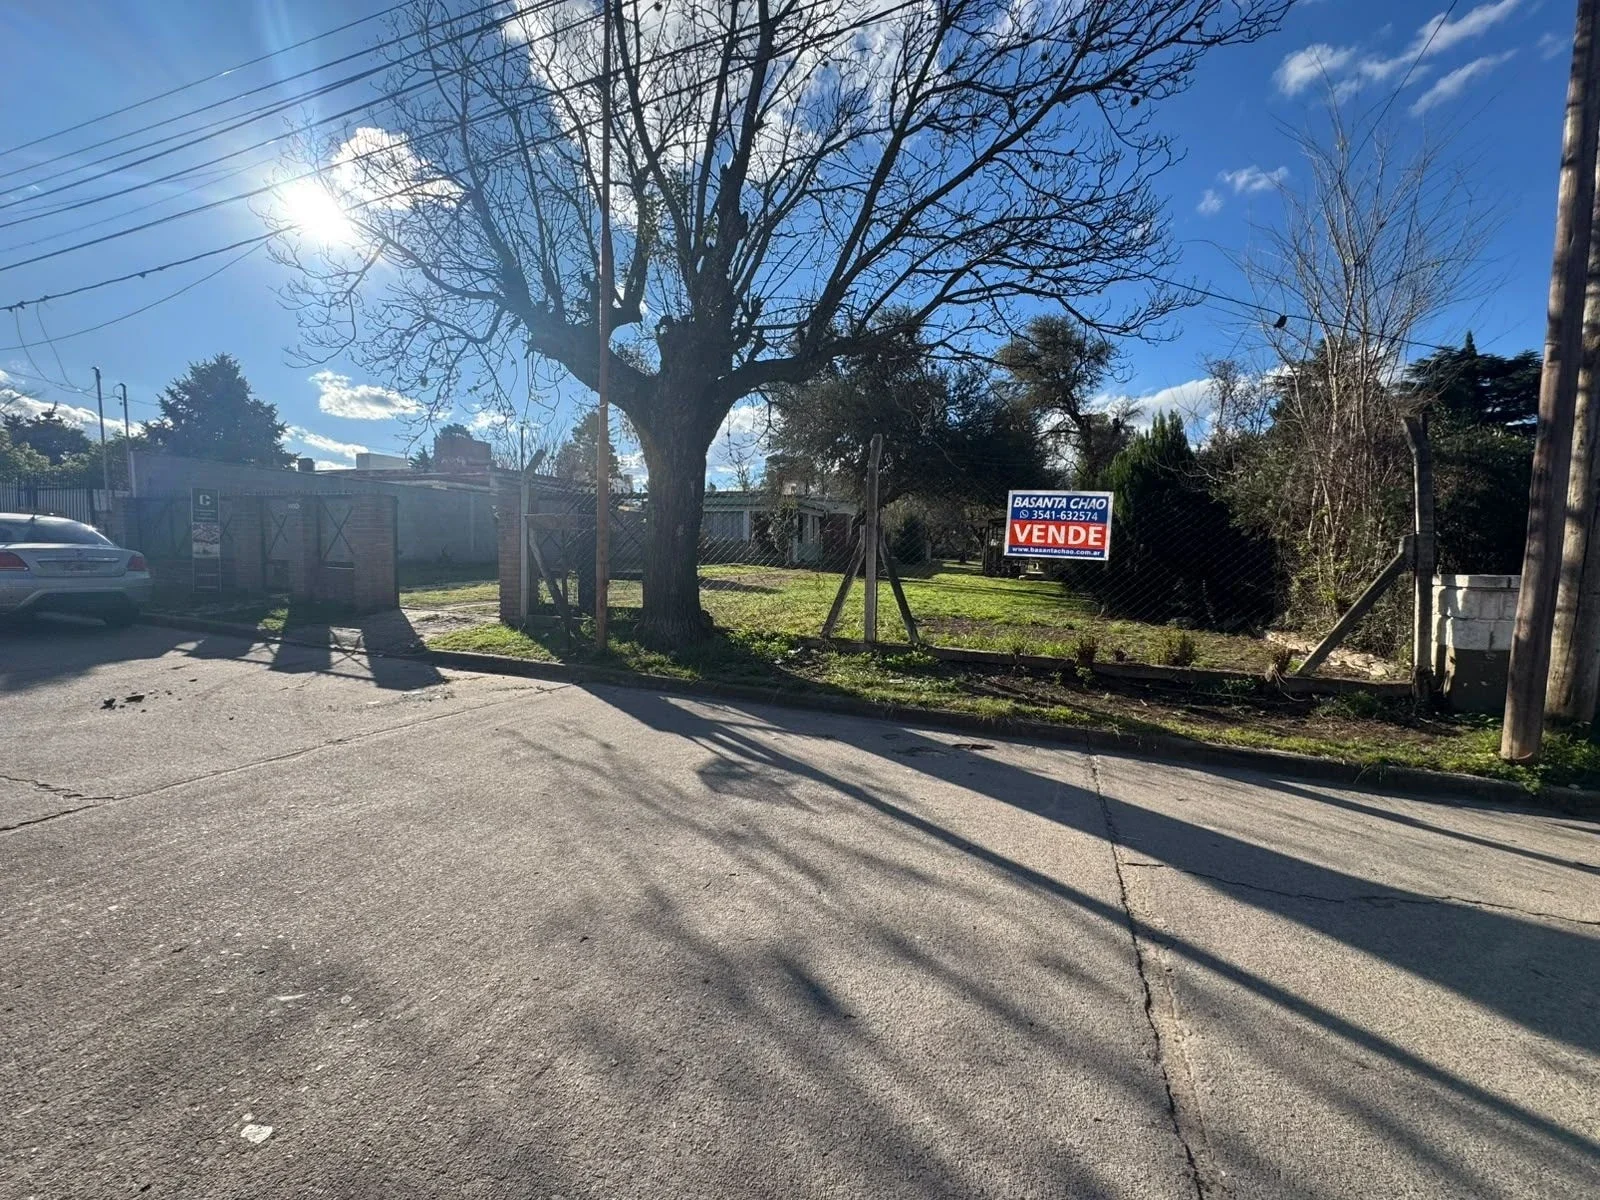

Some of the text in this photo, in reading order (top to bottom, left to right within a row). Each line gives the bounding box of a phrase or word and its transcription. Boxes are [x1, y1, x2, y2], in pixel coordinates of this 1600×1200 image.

[1013, 497, 1106, 510] BASANTA CHAO
[1031, 510, 1097, 520] 3541-632574
[1013, 524, 1102, 546] VENDE
[1012, 547, 1101, 556] www.basantachao.com.ar
